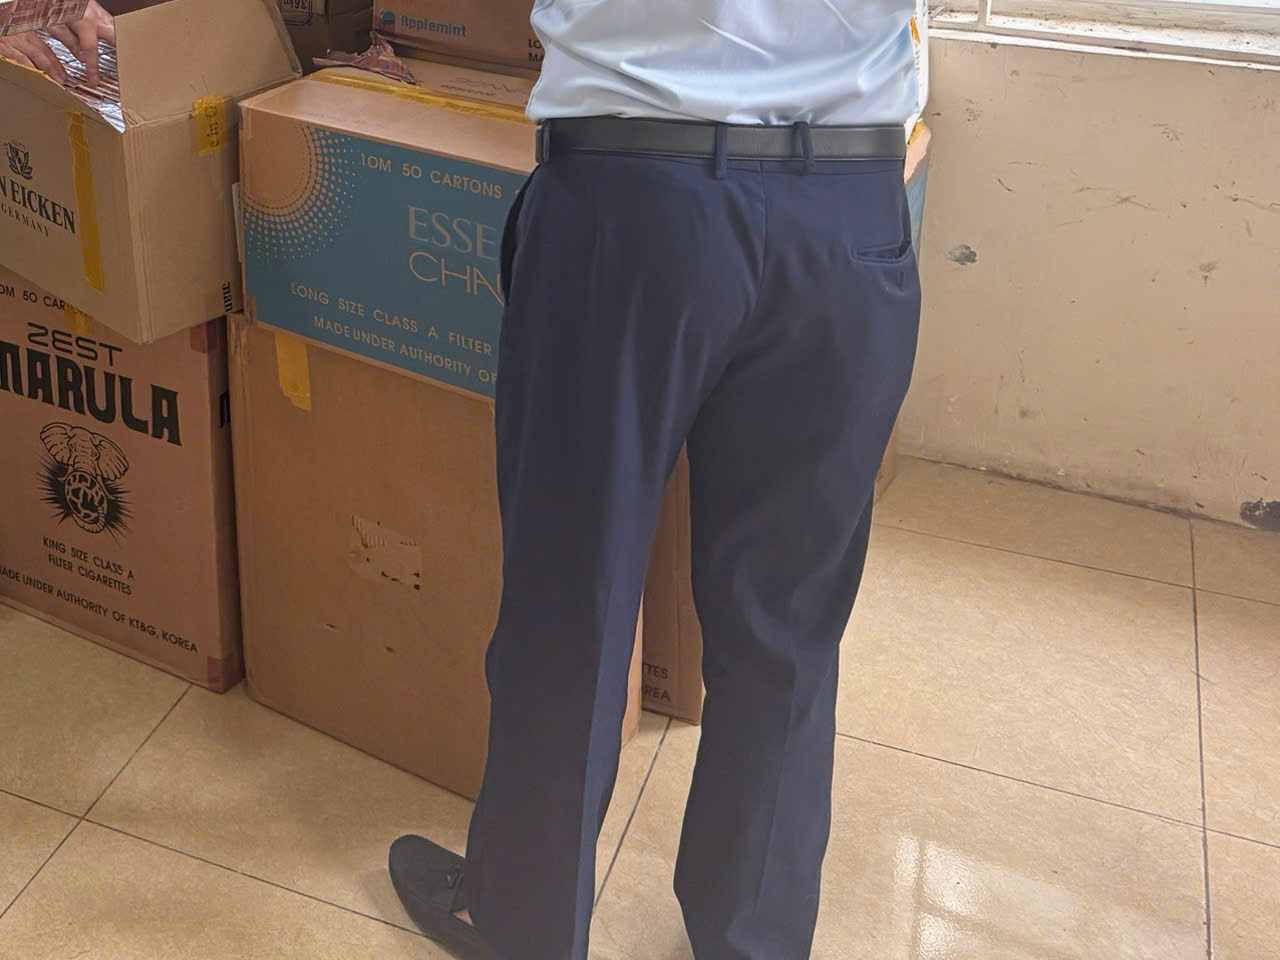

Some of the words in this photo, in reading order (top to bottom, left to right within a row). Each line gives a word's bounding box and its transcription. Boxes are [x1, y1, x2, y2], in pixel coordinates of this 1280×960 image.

[401, 15, 466, 36] Applemint
[527, 38, 543, 50] LO
[527, 52, 545, 63] MA
[360, 152, 392, 173] 10M
[402, 163, 423, 178] 50
[430, 170, 503, 200] CARTONS
[1, 203, 51, 238] GERMANY
[10, 178, 77, 235] EICKEN
[408, 205, 498, 261] ESSE
[23, 290, 38, 303] 50
[290, 281, 329, 305] LONG
[338, 296, 365, 317] SIZE
[373, 309, 418, 333] CLASS
[427, 326, 439, 341] A
[448, 333, 492, 356] FILTER
[27, 321, 123, 367] ZEST
[313, 315, 351, 338] MADE
[352, 327, 396, 352] UNDER
[399, 343, 472, 376] AUTHORITY
[478, 368, 498, 385] OF
[43, 536, 67, 555] KING
[71, 545, 89, 564] SIZE
[93, 554, 124, 577] CLASS
[127, 568, 136, 582] A
[48, 553, 74, 575] FILTER
[77, 564, 132, 596] CIGARETTES
[22, 574, 54, 597] UNDER
[56, 588, 109, 618] AUTHORITY
[112, 609, 127, 624] OF
[161, 629, 198, 654] KOREA
[642, 663, 669, 680] TES
